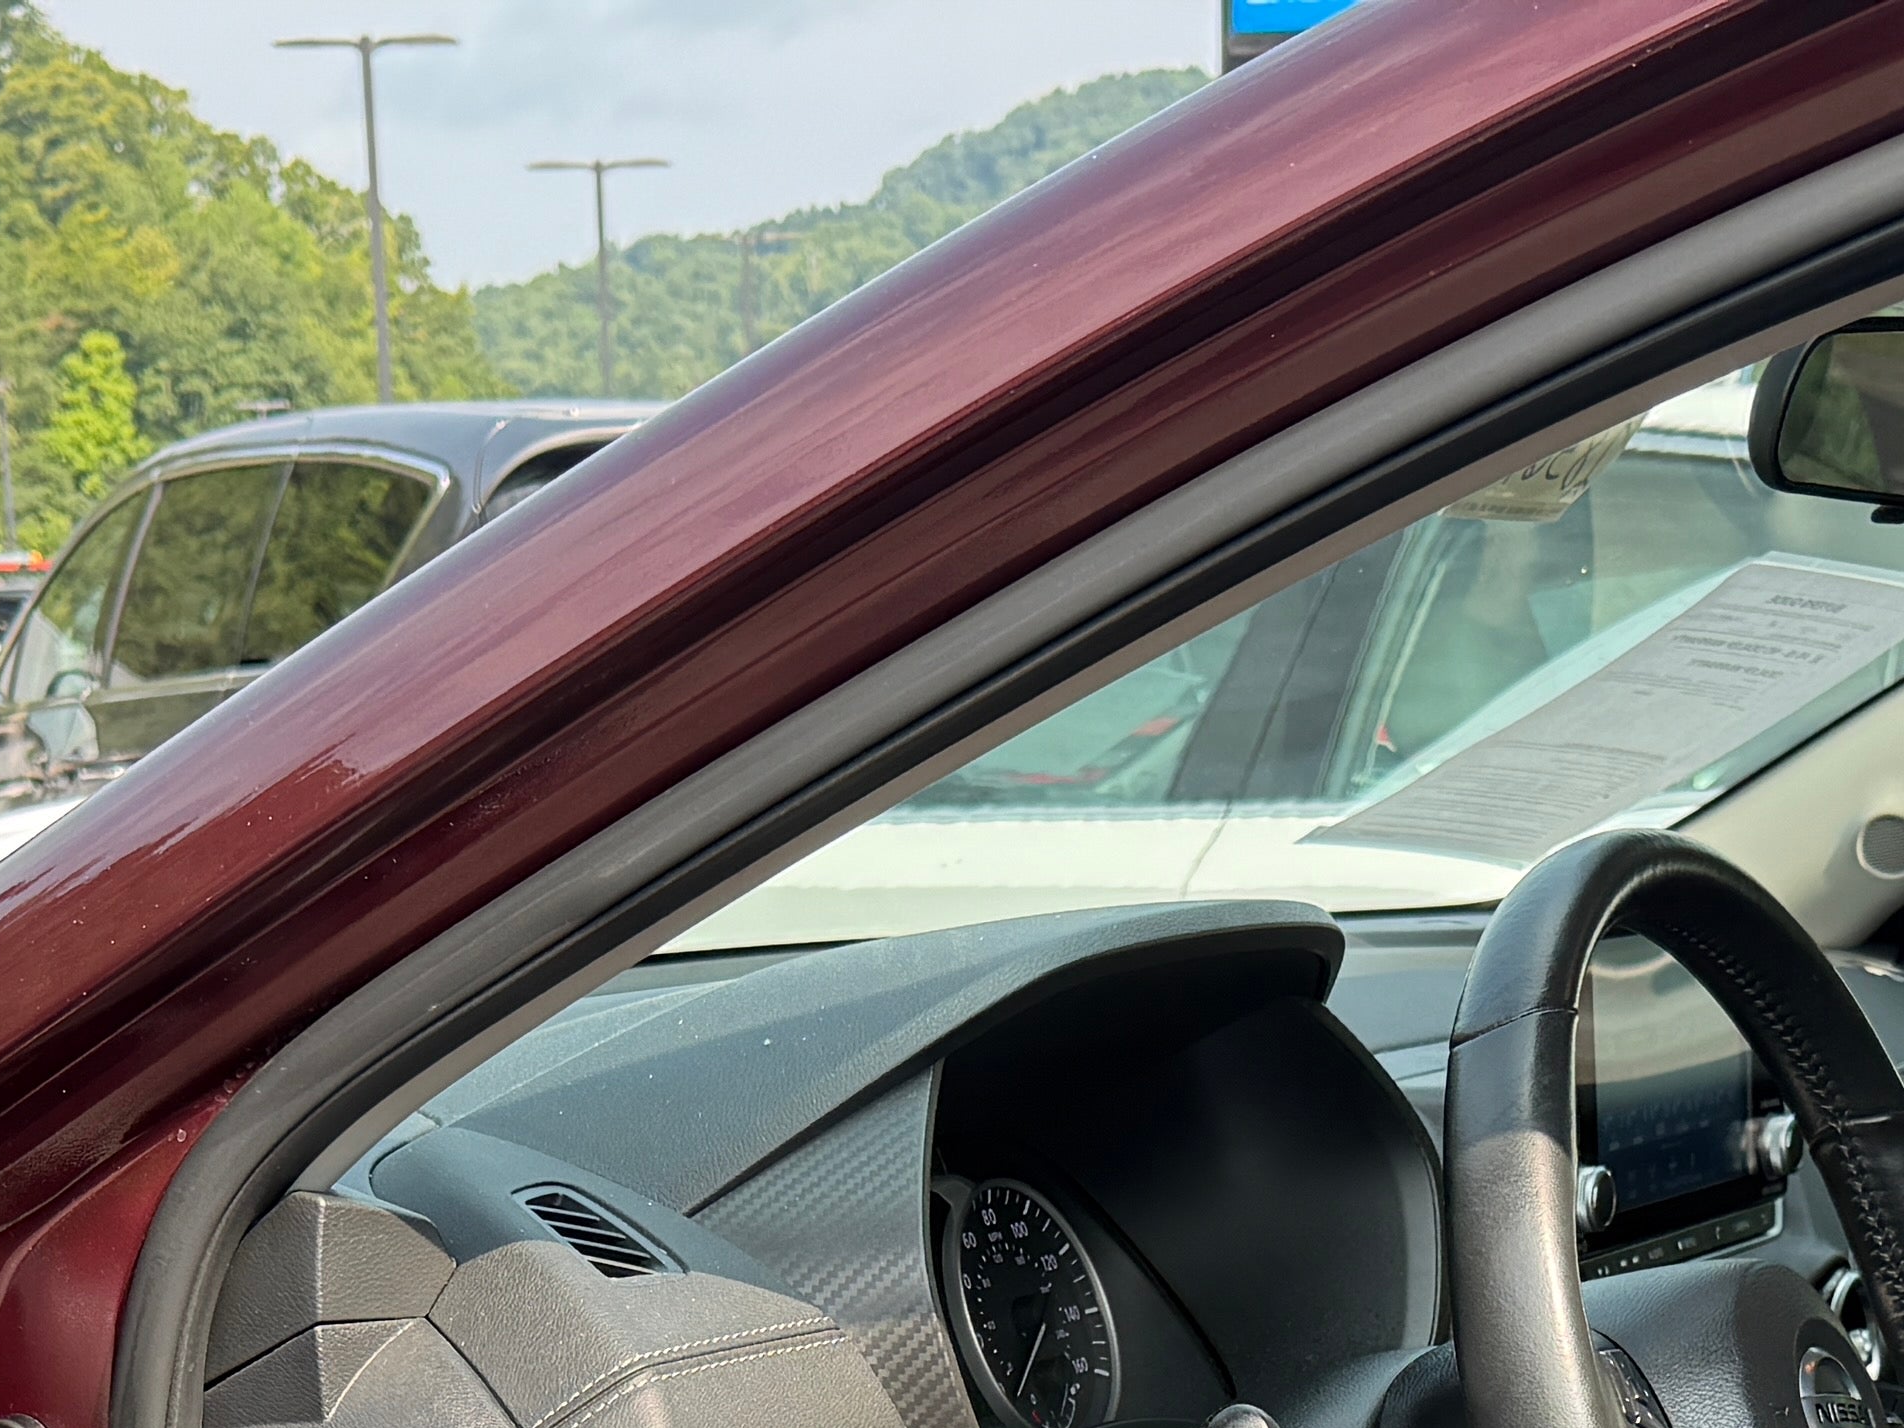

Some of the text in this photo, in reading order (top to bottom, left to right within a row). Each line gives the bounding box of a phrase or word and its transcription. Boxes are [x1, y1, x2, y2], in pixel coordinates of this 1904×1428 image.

[981, 1208, 997, 1226] 80
[1010, 1220, 1029, 1239] 100
[962, 1231, 977, 1249] 60
[1041, 1253, 1058, 1271] 120
[1064, 1305, 1081, 1322] 140
[1072, 1356, 1089, 1374] 160
